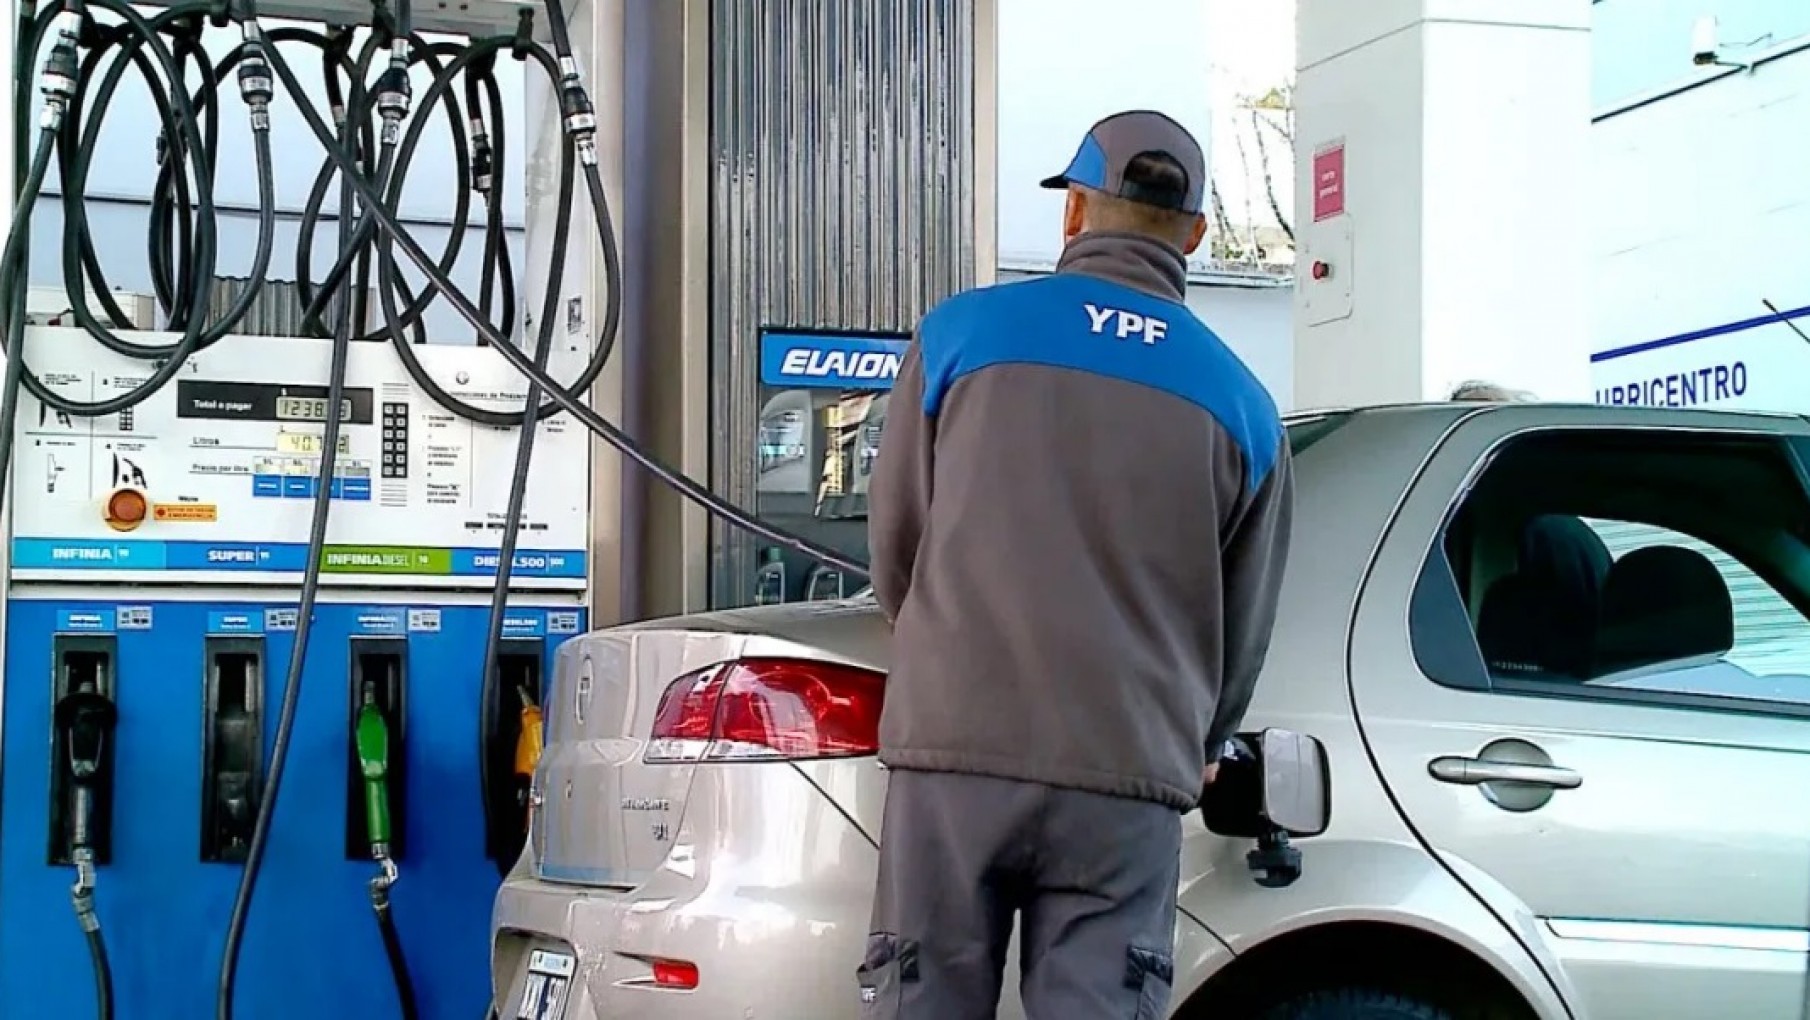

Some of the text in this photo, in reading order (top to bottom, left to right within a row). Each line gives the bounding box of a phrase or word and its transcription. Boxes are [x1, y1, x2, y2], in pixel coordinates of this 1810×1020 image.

[1083, 304, 1167, 344] YPF
[780, 348, 904, 379] ELAION
[193, 399, 217, 409] Total
[225, 402, 253, 412] pagar
[53, 548, 113, 560] INFINIA
[208, 550, 255, 562] SUPER
